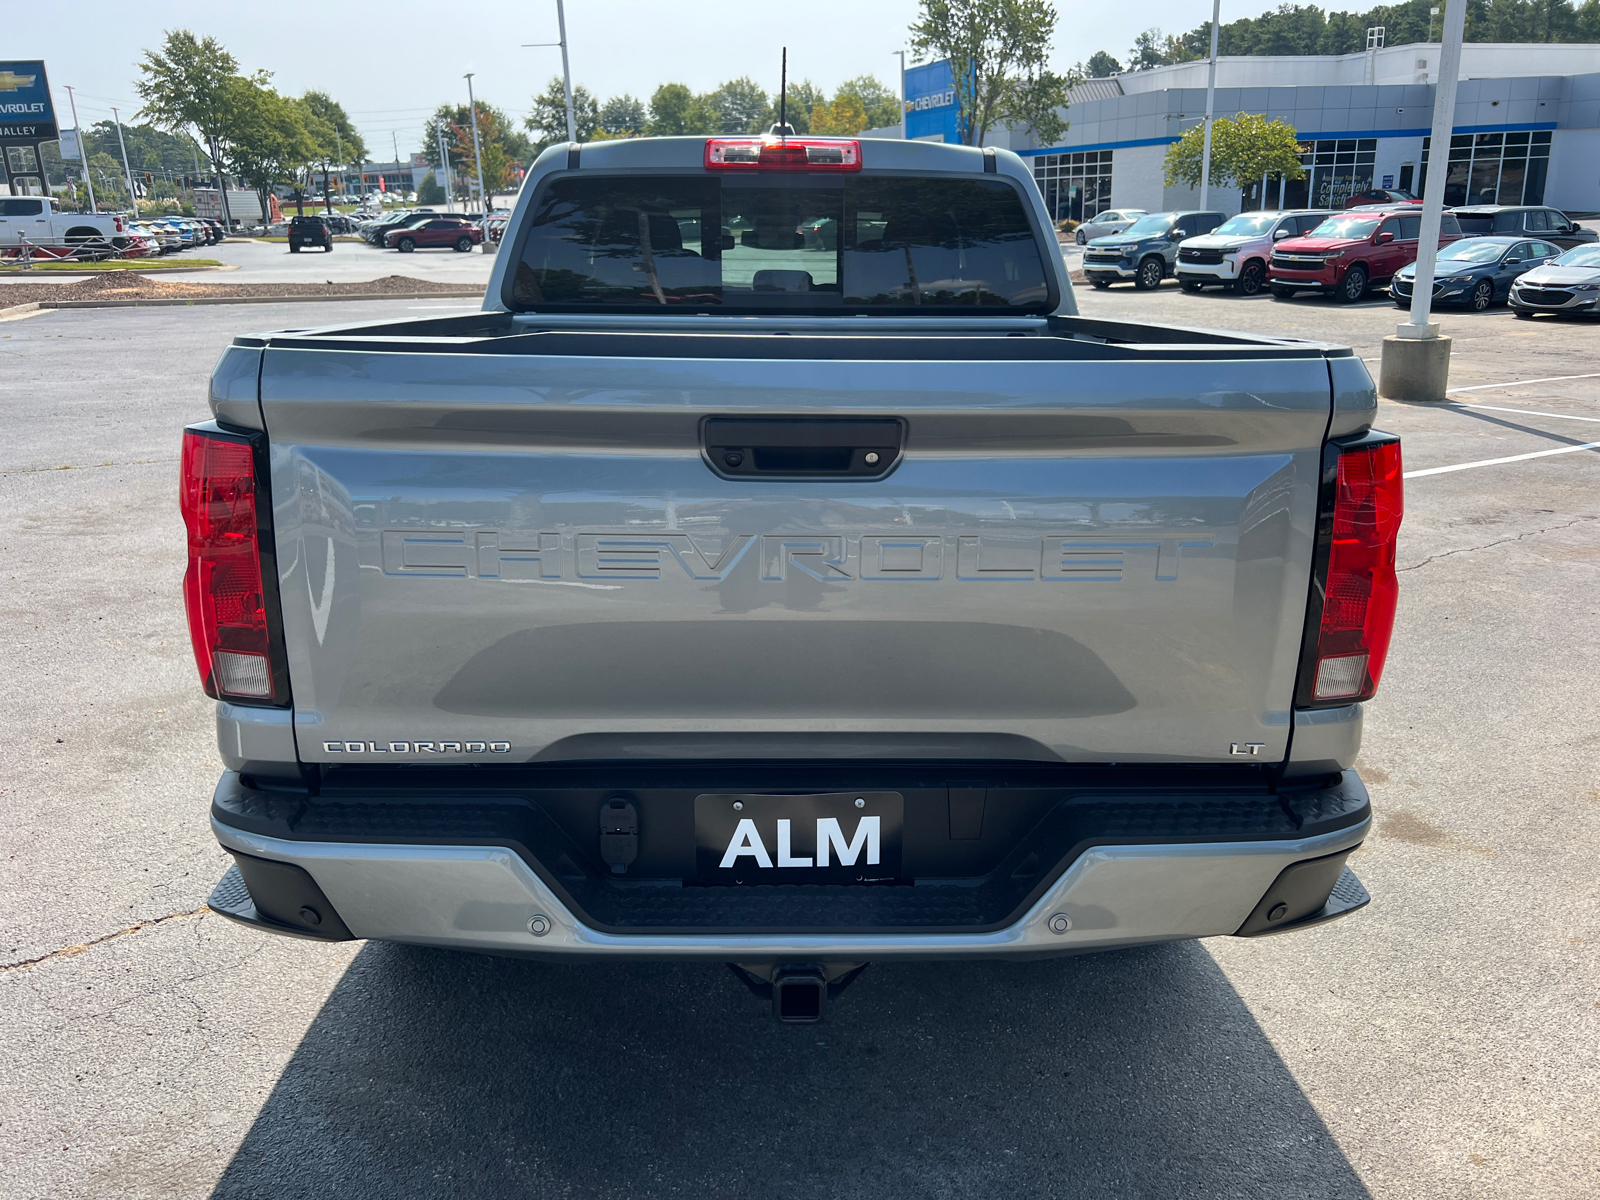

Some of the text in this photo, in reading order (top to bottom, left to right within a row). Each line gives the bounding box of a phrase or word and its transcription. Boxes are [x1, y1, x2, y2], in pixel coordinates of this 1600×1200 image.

[0, 102, 45, 113] VROLET
[914, 91, 955, 112] CHEVROLET
[378, 528, 1215, 582] CHEVROLET
[322, 740, 512, 753] COLORADO
[1229, 742, 1266, 755] LT
[718, 815, 881, 869] ALM
